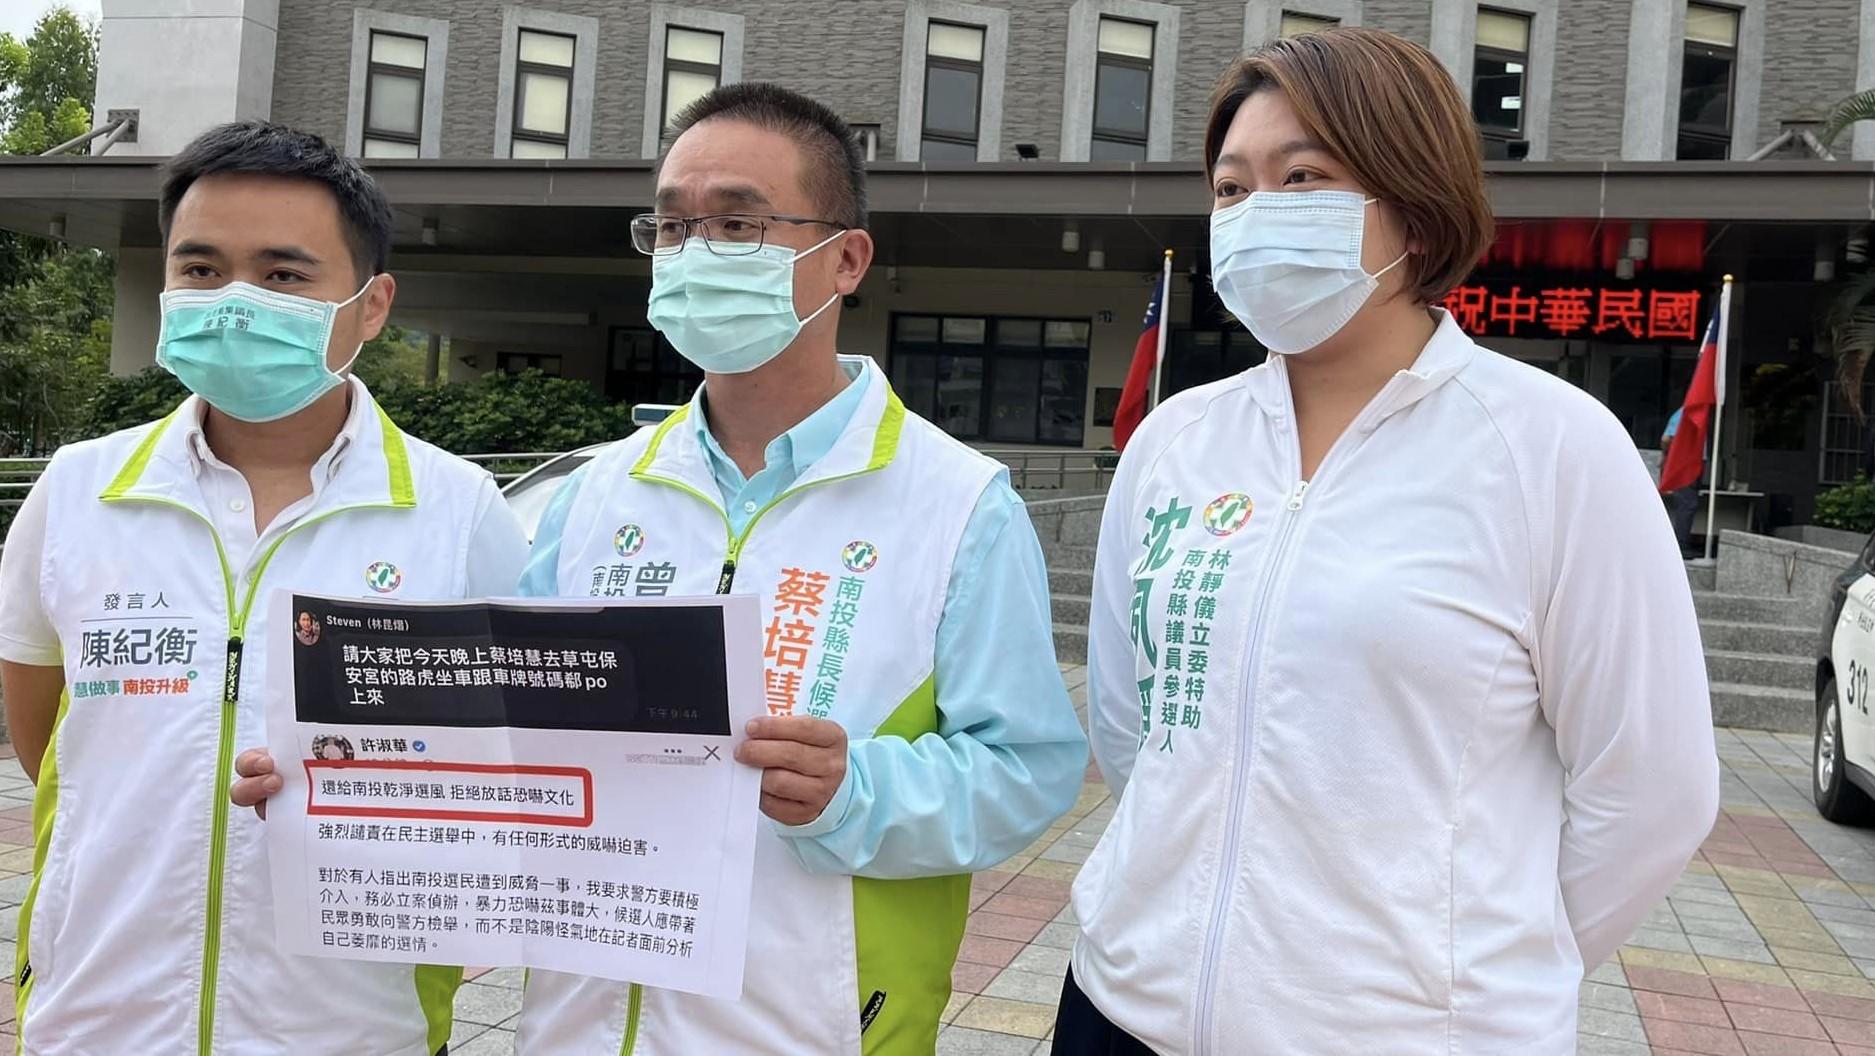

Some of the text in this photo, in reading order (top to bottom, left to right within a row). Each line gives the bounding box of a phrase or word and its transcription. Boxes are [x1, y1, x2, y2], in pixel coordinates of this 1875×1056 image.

[1442, 285, 1702, 340] 祝中華民國
[103, 592, 169, 611] 發言人
[326, 615, 362, 628] Steven
[79, 628, 197, 670] 陳紀衡
[1159, 549, 1205, 754] 南投縣議員參選人
[1180, 549, 1232, 730] 林靜儀立委特助
[342, 644, 618, 670] 請大家把今天晚上蔡培慧去草屯保
[123, 677, 189, 696] 南投升級
[585, 675, 608, 691] po
[1847, 658, 1869, 715] 312
[350, 687, 385, 706] 上來
[360, 738, 409, 753] 許淑華
[321, 779, 574, 807] 還給南投乾淨選風 拒絕放話恐嚇文化
